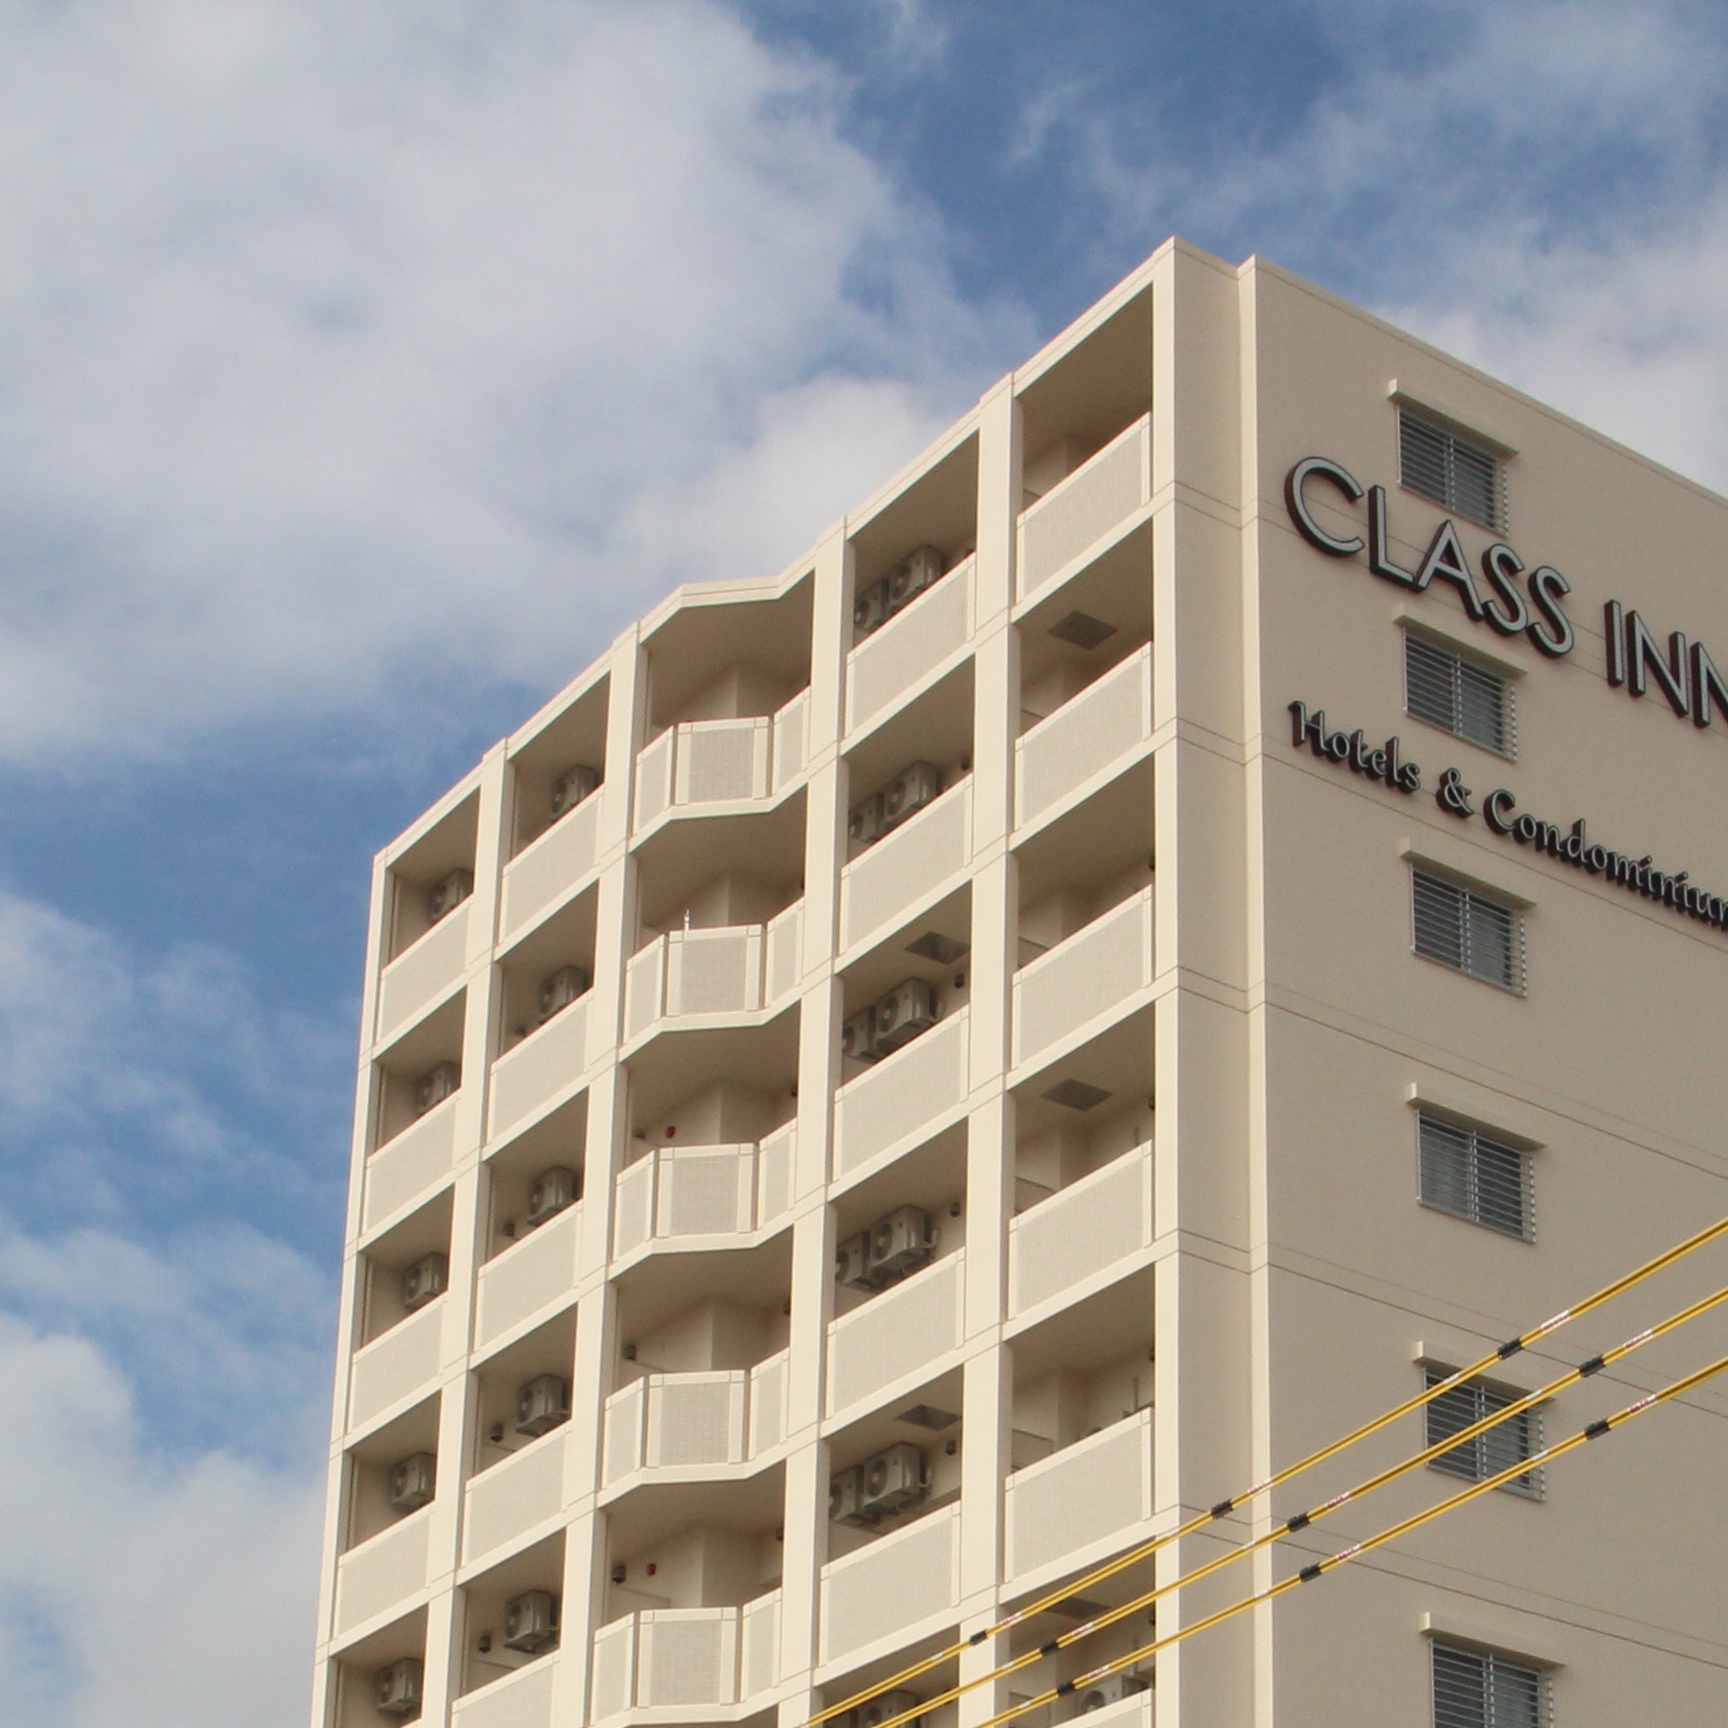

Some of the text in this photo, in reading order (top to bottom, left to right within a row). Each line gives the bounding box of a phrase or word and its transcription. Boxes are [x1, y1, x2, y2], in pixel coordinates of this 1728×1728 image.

[1284, 455, 1574, 658] CLASS
[1287, 699, 1421, 793] Hotels
[1435, 767, 1474, 817] &
